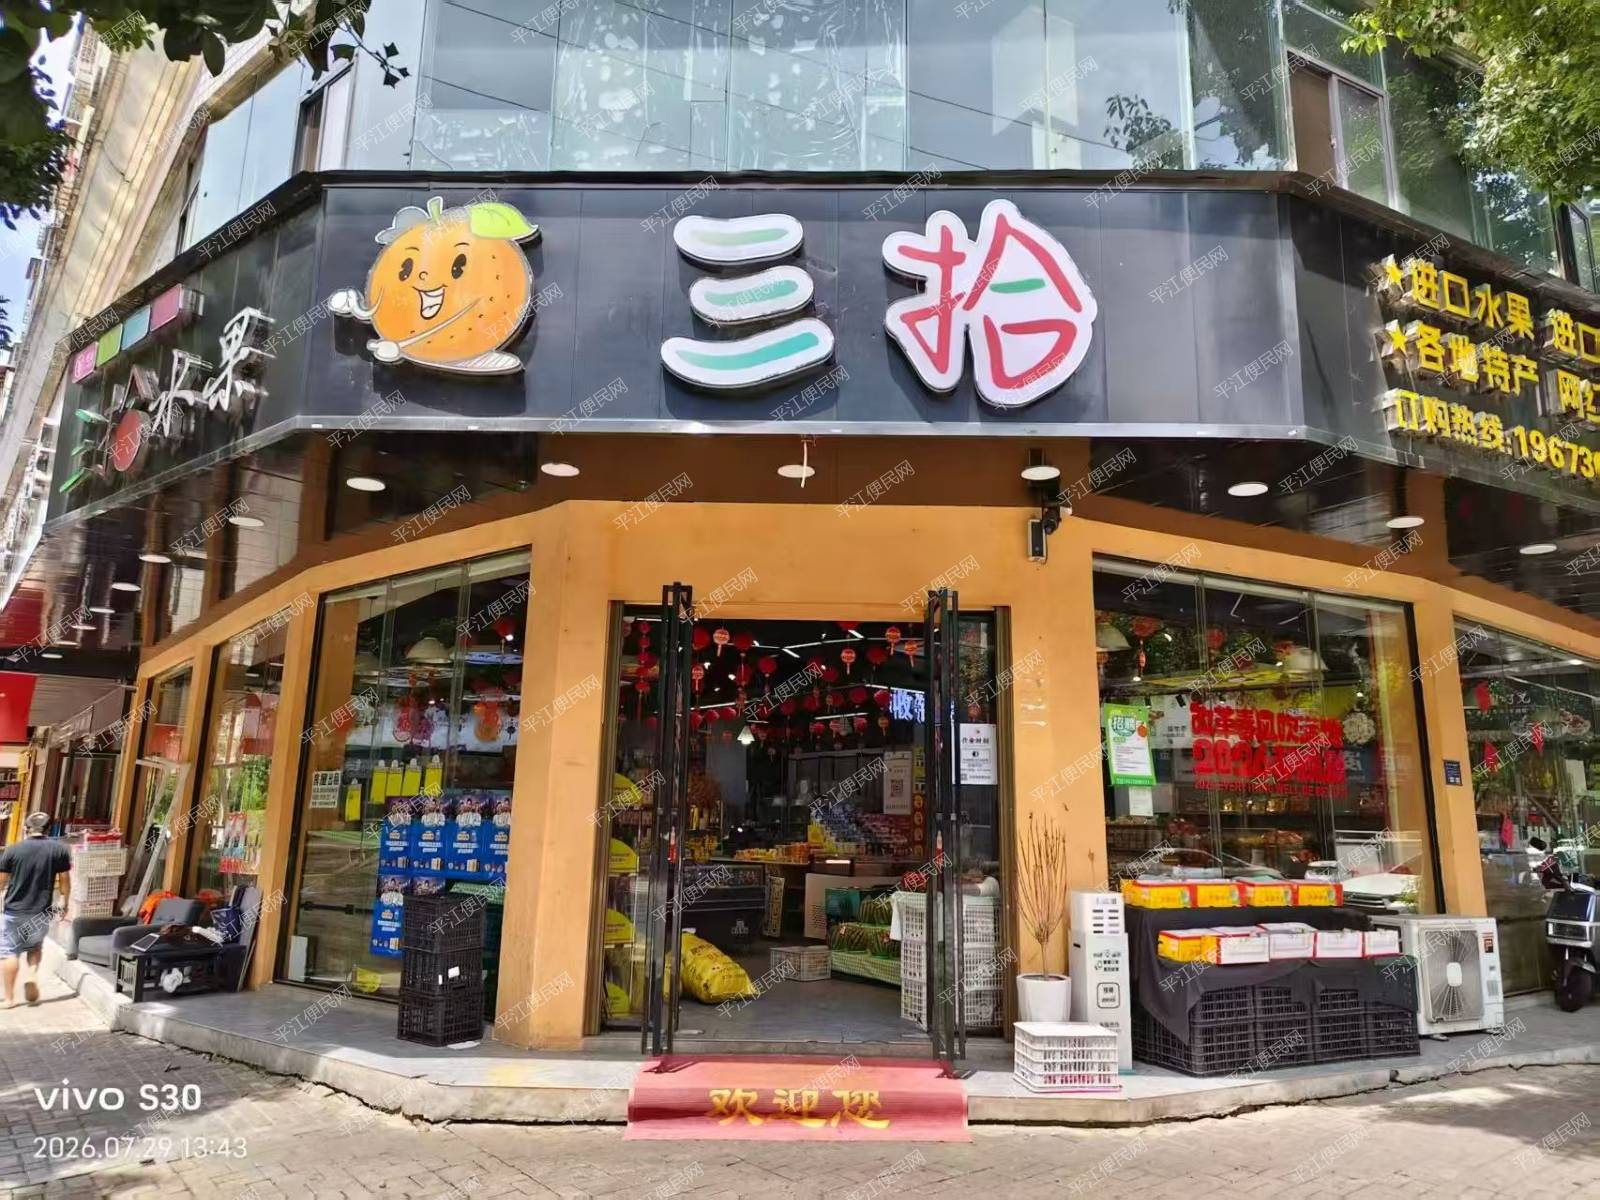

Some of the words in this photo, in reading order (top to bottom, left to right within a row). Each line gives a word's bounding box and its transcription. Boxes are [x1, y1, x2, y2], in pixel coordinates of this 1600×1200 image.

[1408, 258, 1534, 341] 进口水果
[1414, 321, 1539, 397] 各地特产
[707, 1087, 891, 1129] 欢迎您
